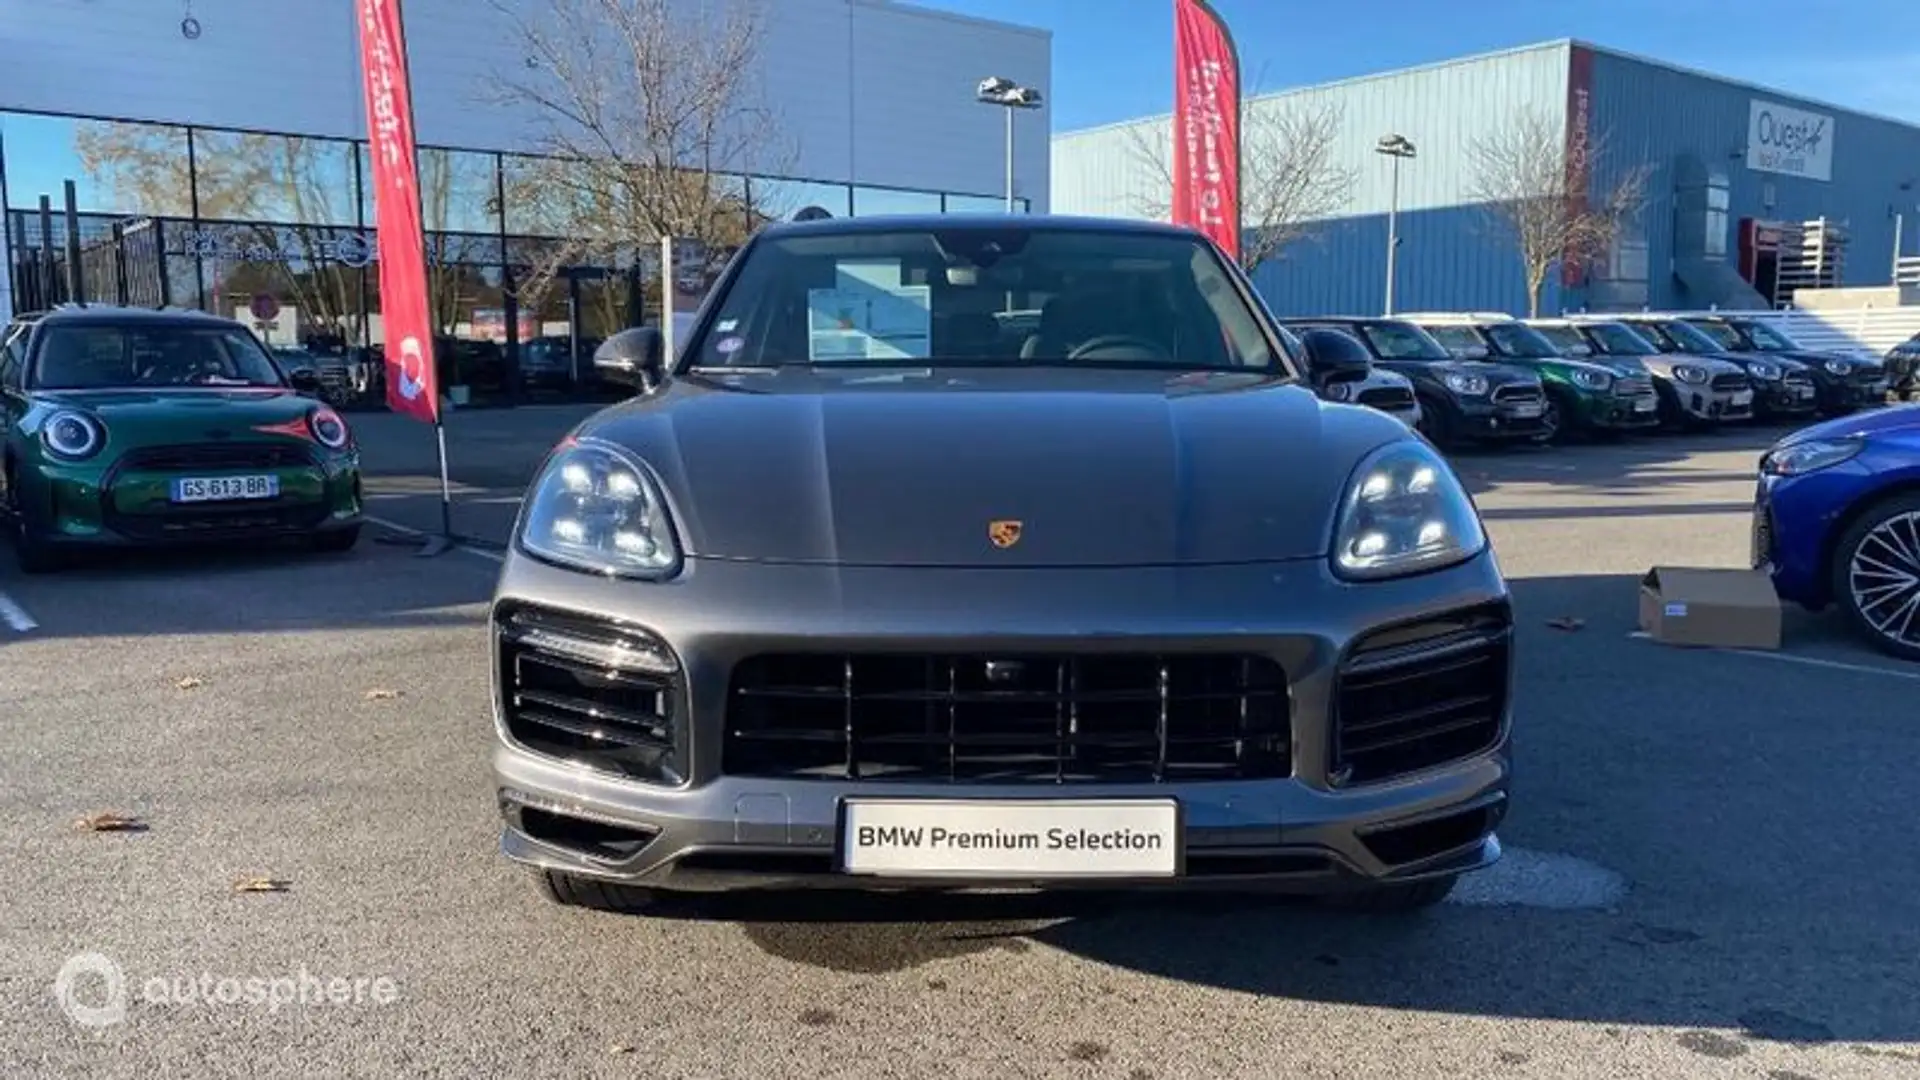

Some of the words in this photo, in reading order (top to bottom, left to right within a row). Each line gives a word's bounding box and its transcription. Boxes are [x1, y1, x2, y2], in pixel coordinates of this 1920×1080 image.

[858, 826, 924, 847] BMW
[930, 828, 1039, 849] Premium
[1046, 828, 1162, 850] Selection
